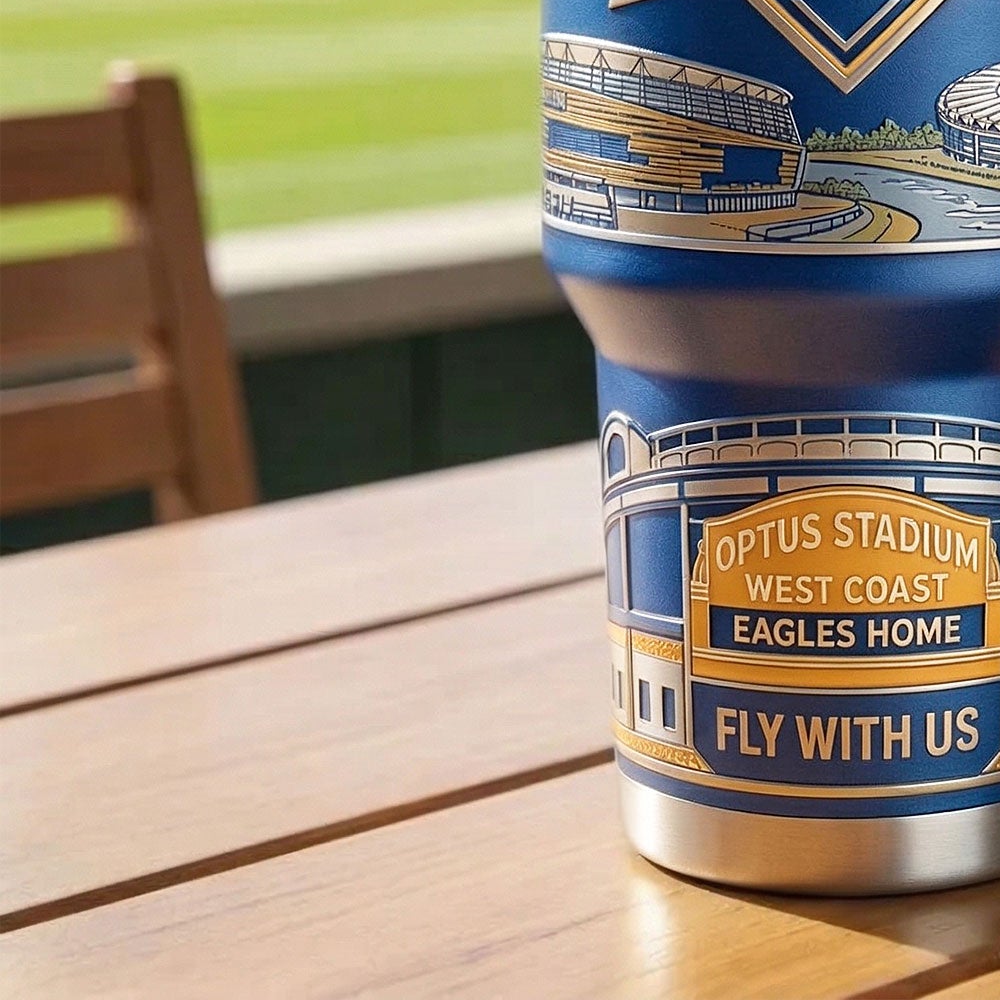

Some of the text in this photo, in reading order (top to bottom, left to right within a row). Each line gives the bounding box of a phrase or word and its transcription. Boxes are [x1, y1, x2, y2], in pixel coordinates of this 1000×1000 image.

[715, 511, 979, 573] OPTUS STADIUM
[744, 573, 949, 604] WEST COAST
[733, 614, 961, 648] EAGLES HOME
[716, 706, 980, 761] FLY WITH US
